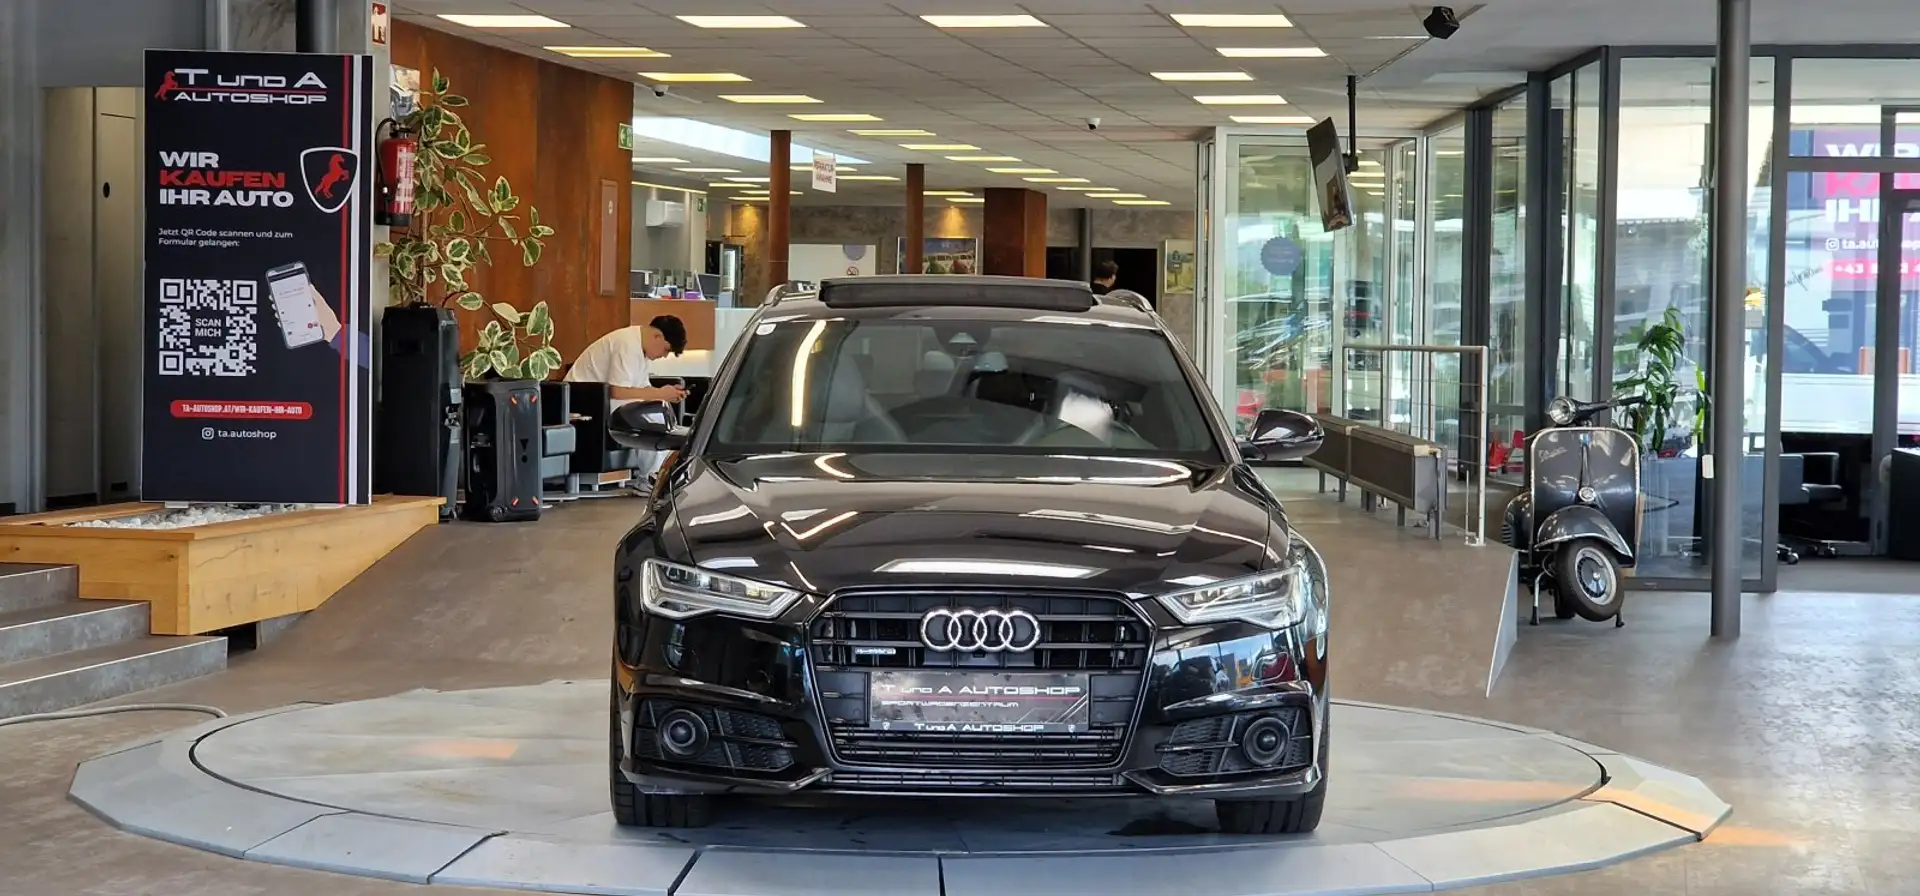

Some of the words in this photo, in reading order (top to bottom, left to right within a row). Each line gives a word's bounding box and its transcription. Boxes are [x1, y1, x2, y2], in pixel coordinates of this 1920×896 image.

[174, 68, 208, 85] T
[293, 71, 327, 89] A
[174, 91, 327, 105] AUTOSHOP
[160, 151, 219, 168] WIR
[160, 170, 285, 188] KAUFEN
[160, 189, 210, 205] IHR
[213, 190, 294, 207] AUTO
[1825, 198, 1879, 222] IH
[158, 228, 179, 236] Jetzt
[181, 229, 194, 237] QR
[196, 229, 217, 237] Code
[219, 230, 254, 238] scannen
[256, 230, 273, 238] und
[158, 238, 197, 246] Formular
[198, 239, 240, 248] gelangen:
[195, 318, 221, 327] SCAN
[195, 328, 221, 337] MICH
[218, 429, 277, 440] ta.autoshop
[937, 685, 953, 694] A
[959, 685, 1081, 695] AUTOSHOP
[962, 723, 1044, 732] AUTOSHOP
